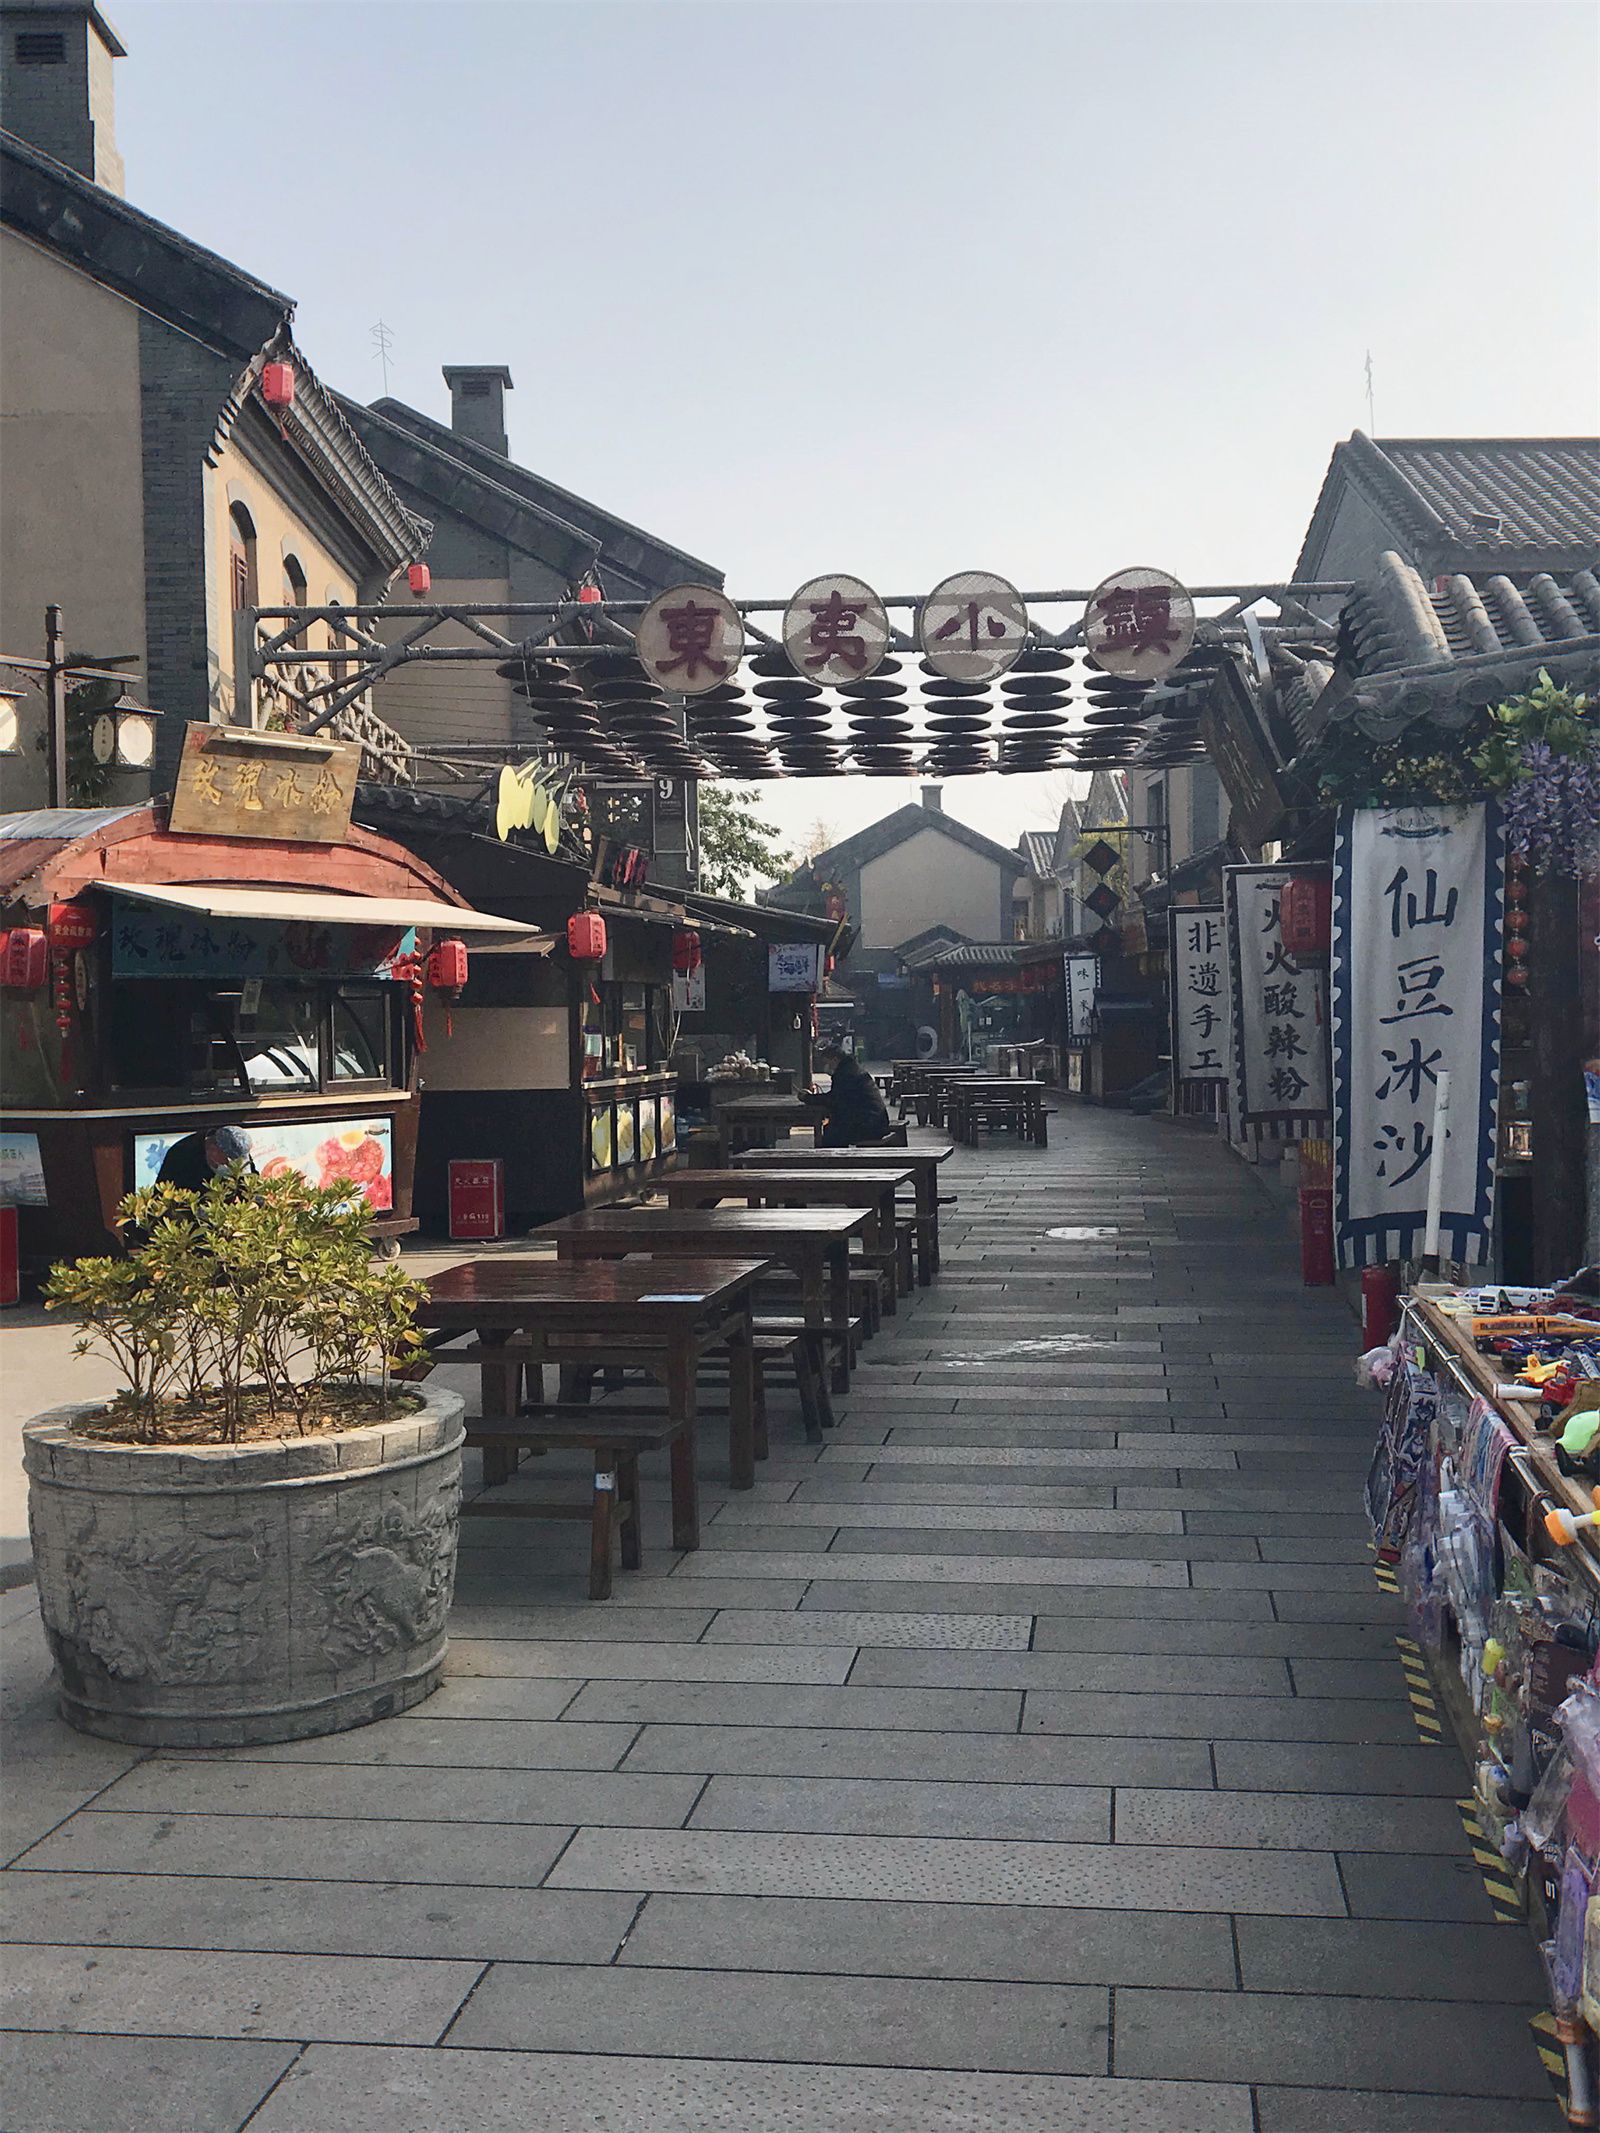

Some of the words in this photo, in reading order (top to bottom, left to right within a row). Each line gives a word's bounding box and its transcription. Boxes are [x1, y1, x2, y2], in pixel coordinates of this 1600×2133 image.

[191, 757, 345, 815] 玫瑰冰粉
[1188, 918, 1223, 1071] 非遗手工
[1374, 866, 1459, 1188] 仙豆冰沙
